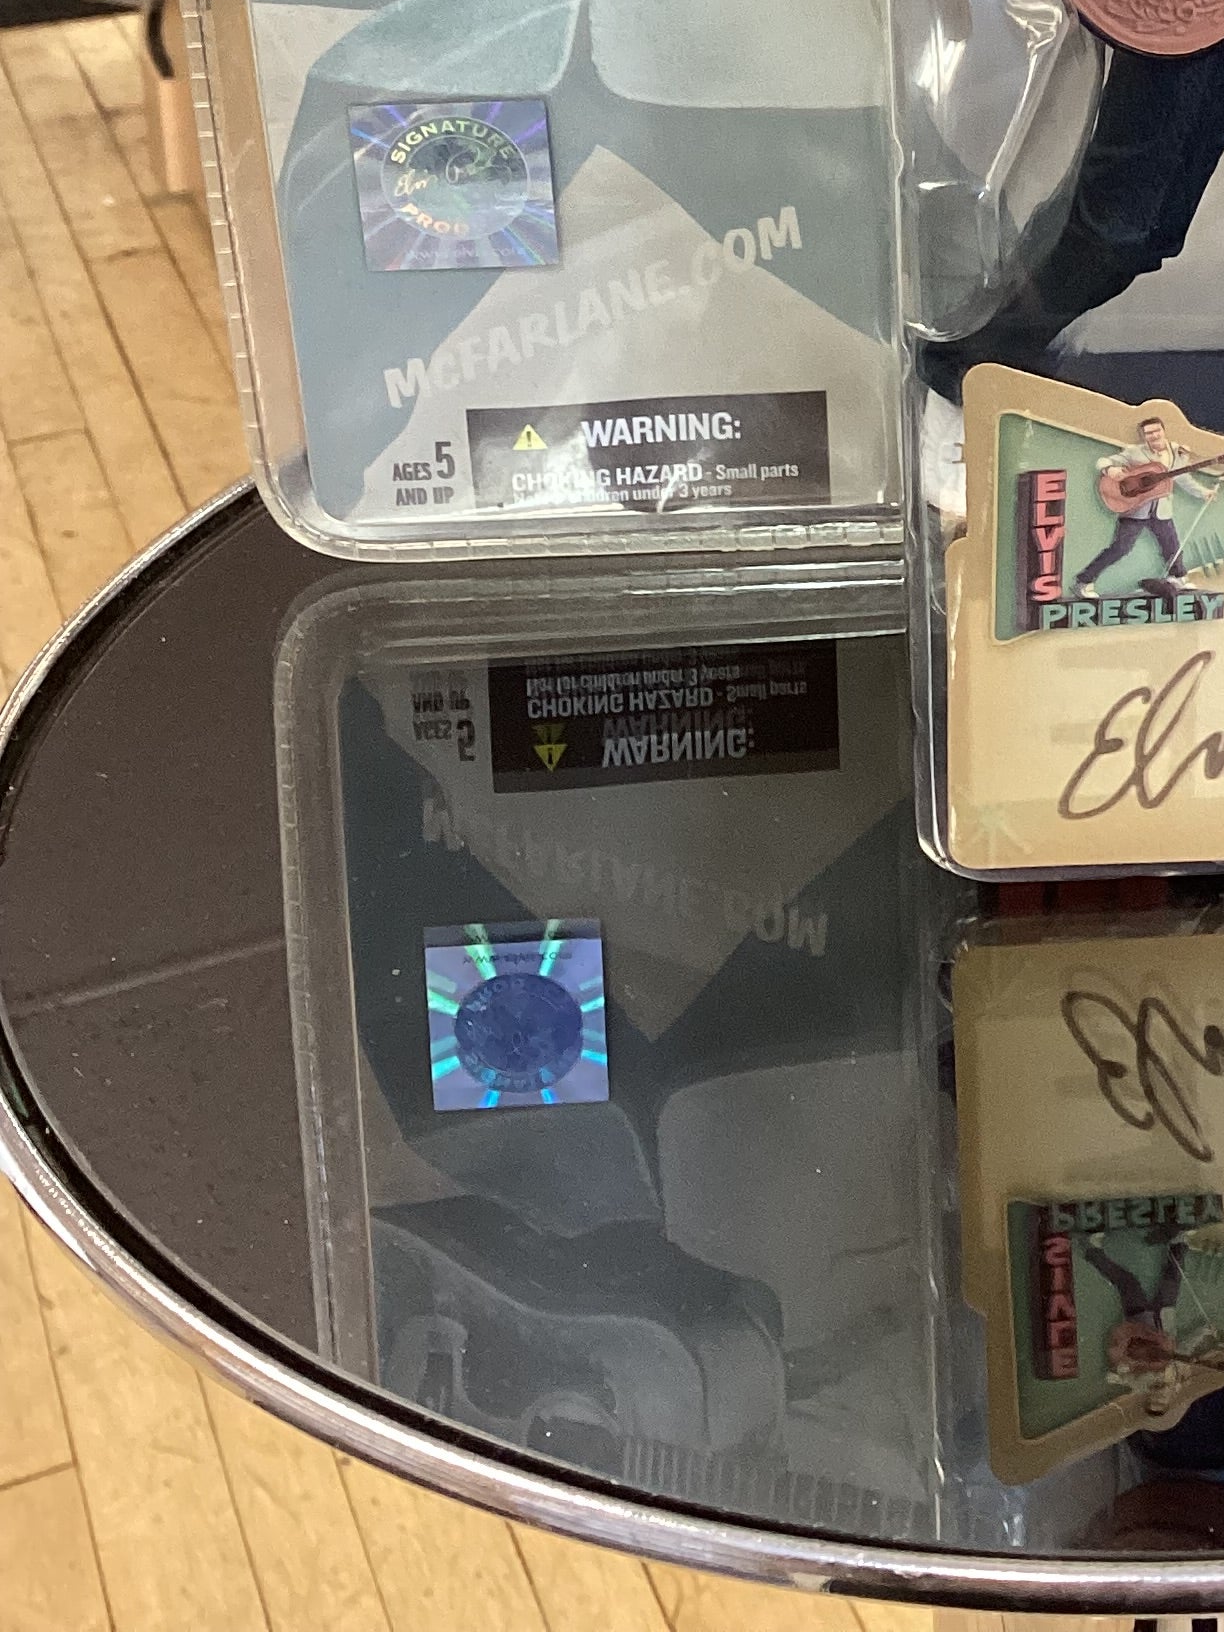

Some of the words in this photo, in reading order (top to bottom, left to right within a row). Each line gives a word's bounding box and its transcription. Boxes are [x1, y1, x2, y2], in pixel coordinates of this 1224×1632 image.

[391, 120, 518, 165] SIGNATURE
[383, 205, 803, 409] MCFARLANE.COM
[580, 411, 742, 449] WARNING:
[392, 461, 432, 482] AGES
[434, 441, 456, 480] 5
[616, 462, 703, 486] HAZARD
[716, 463, 758, 481] Small
[760, 463, 800, 481] parts
[395, 487, 427, 506] AND
[432, 486, 454, 505] UP
[691, 484, 733, 500] years
[1031, 470, 1068, 602] ELVIS
[1041, 593, 1224, 630] PRESLEY
